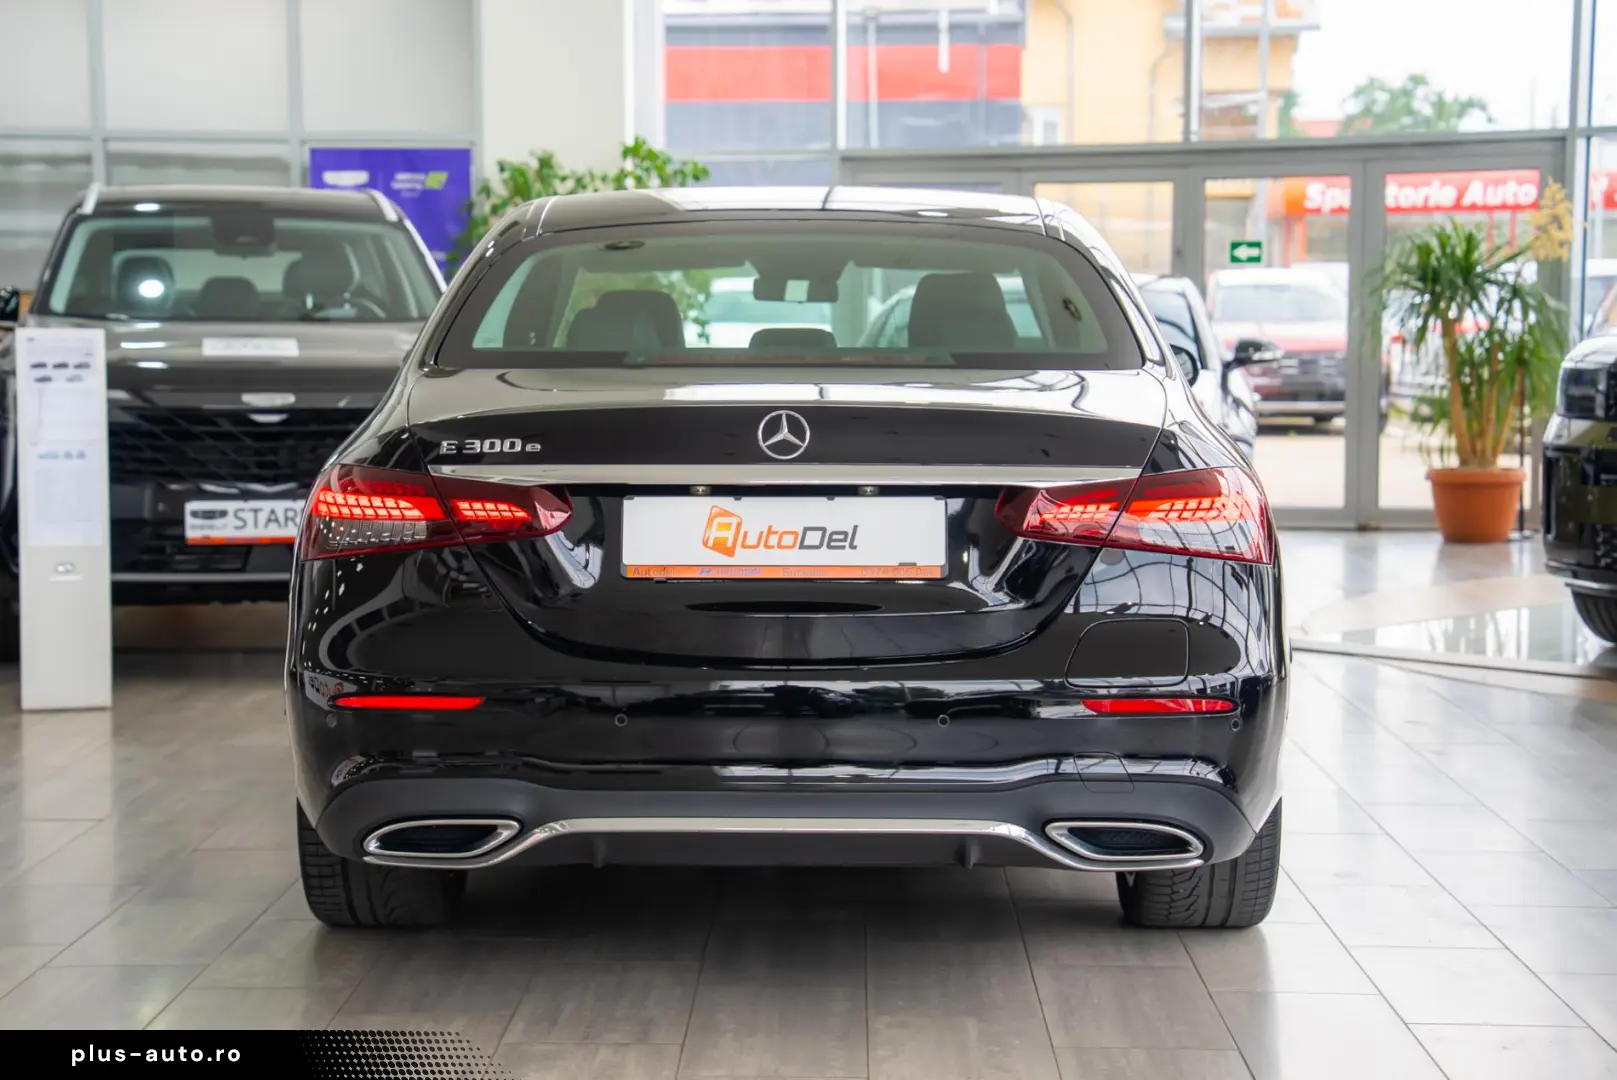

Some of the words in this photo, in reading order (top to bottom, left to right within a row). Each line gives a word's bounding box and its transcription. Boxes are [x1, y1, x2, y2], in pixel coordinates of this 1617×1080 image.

[1460, 179, 1538, 207] Auto
[233, 508, 302, 530] STAR
[702, 505, 859, 558] AutoDel
